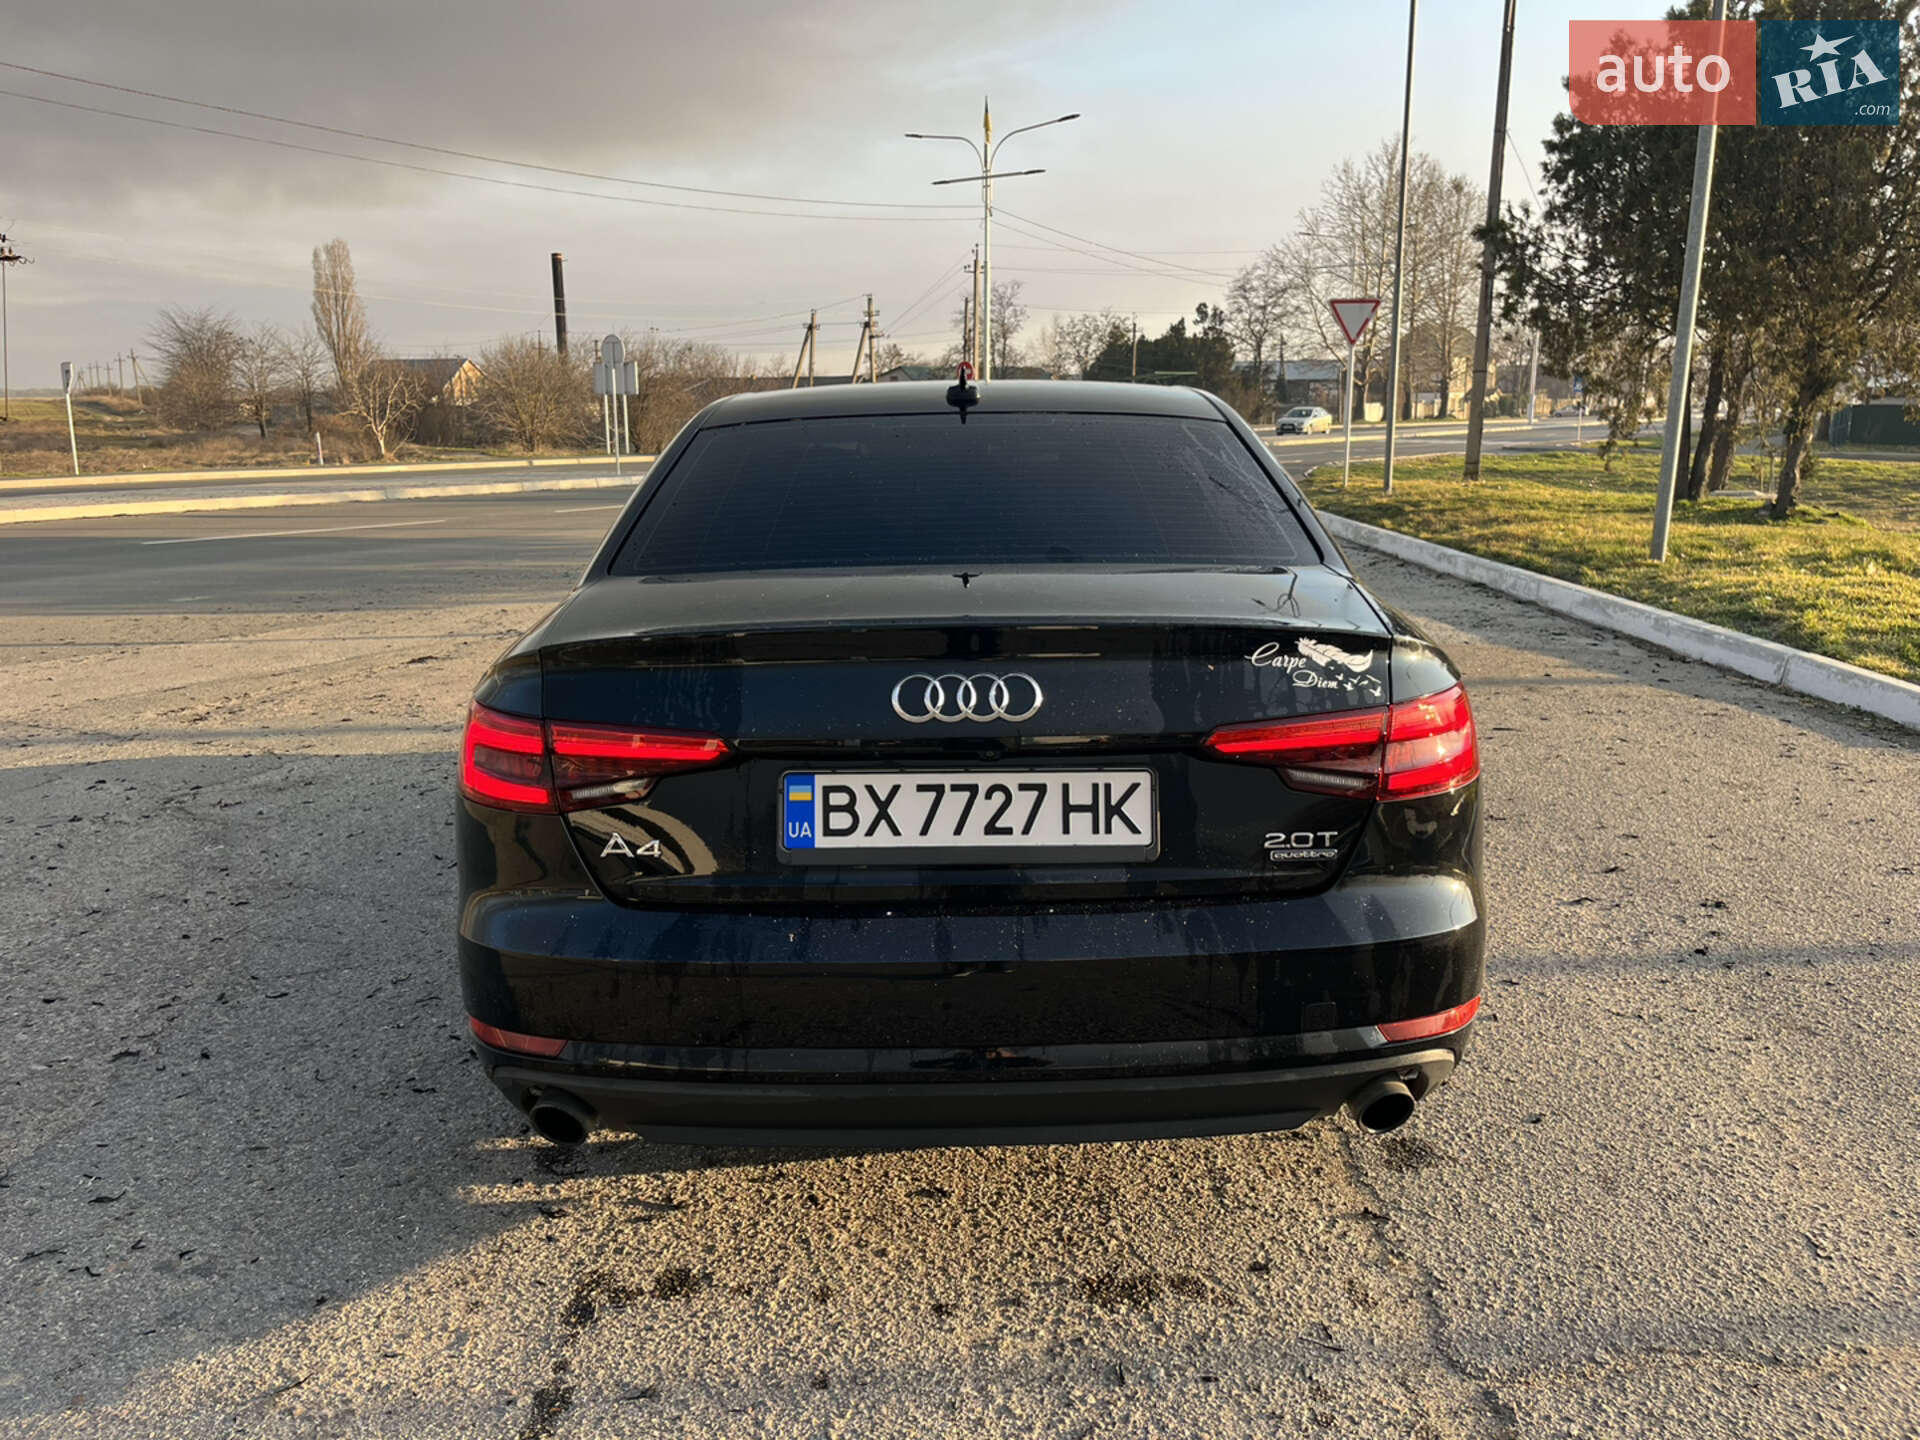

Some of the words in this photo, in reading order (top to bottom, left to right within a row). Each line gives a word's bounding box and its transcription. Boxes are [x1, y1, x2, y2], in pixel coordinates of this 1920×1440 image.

[1244, 642, 1307, 674] Carpe
[1292, 670, 1338, 689] Diem
[822, 784, 901, 837] BX
[916, 782, 1048, 836] 7727
[1061, 782, 1141, 835] HK
[788, 821, 812, 838] UA
[600, 832, 661, 858] A4
[1264, 831, 1338, 848] 2.0T
[1273, 850, 1335, 859] quattro
